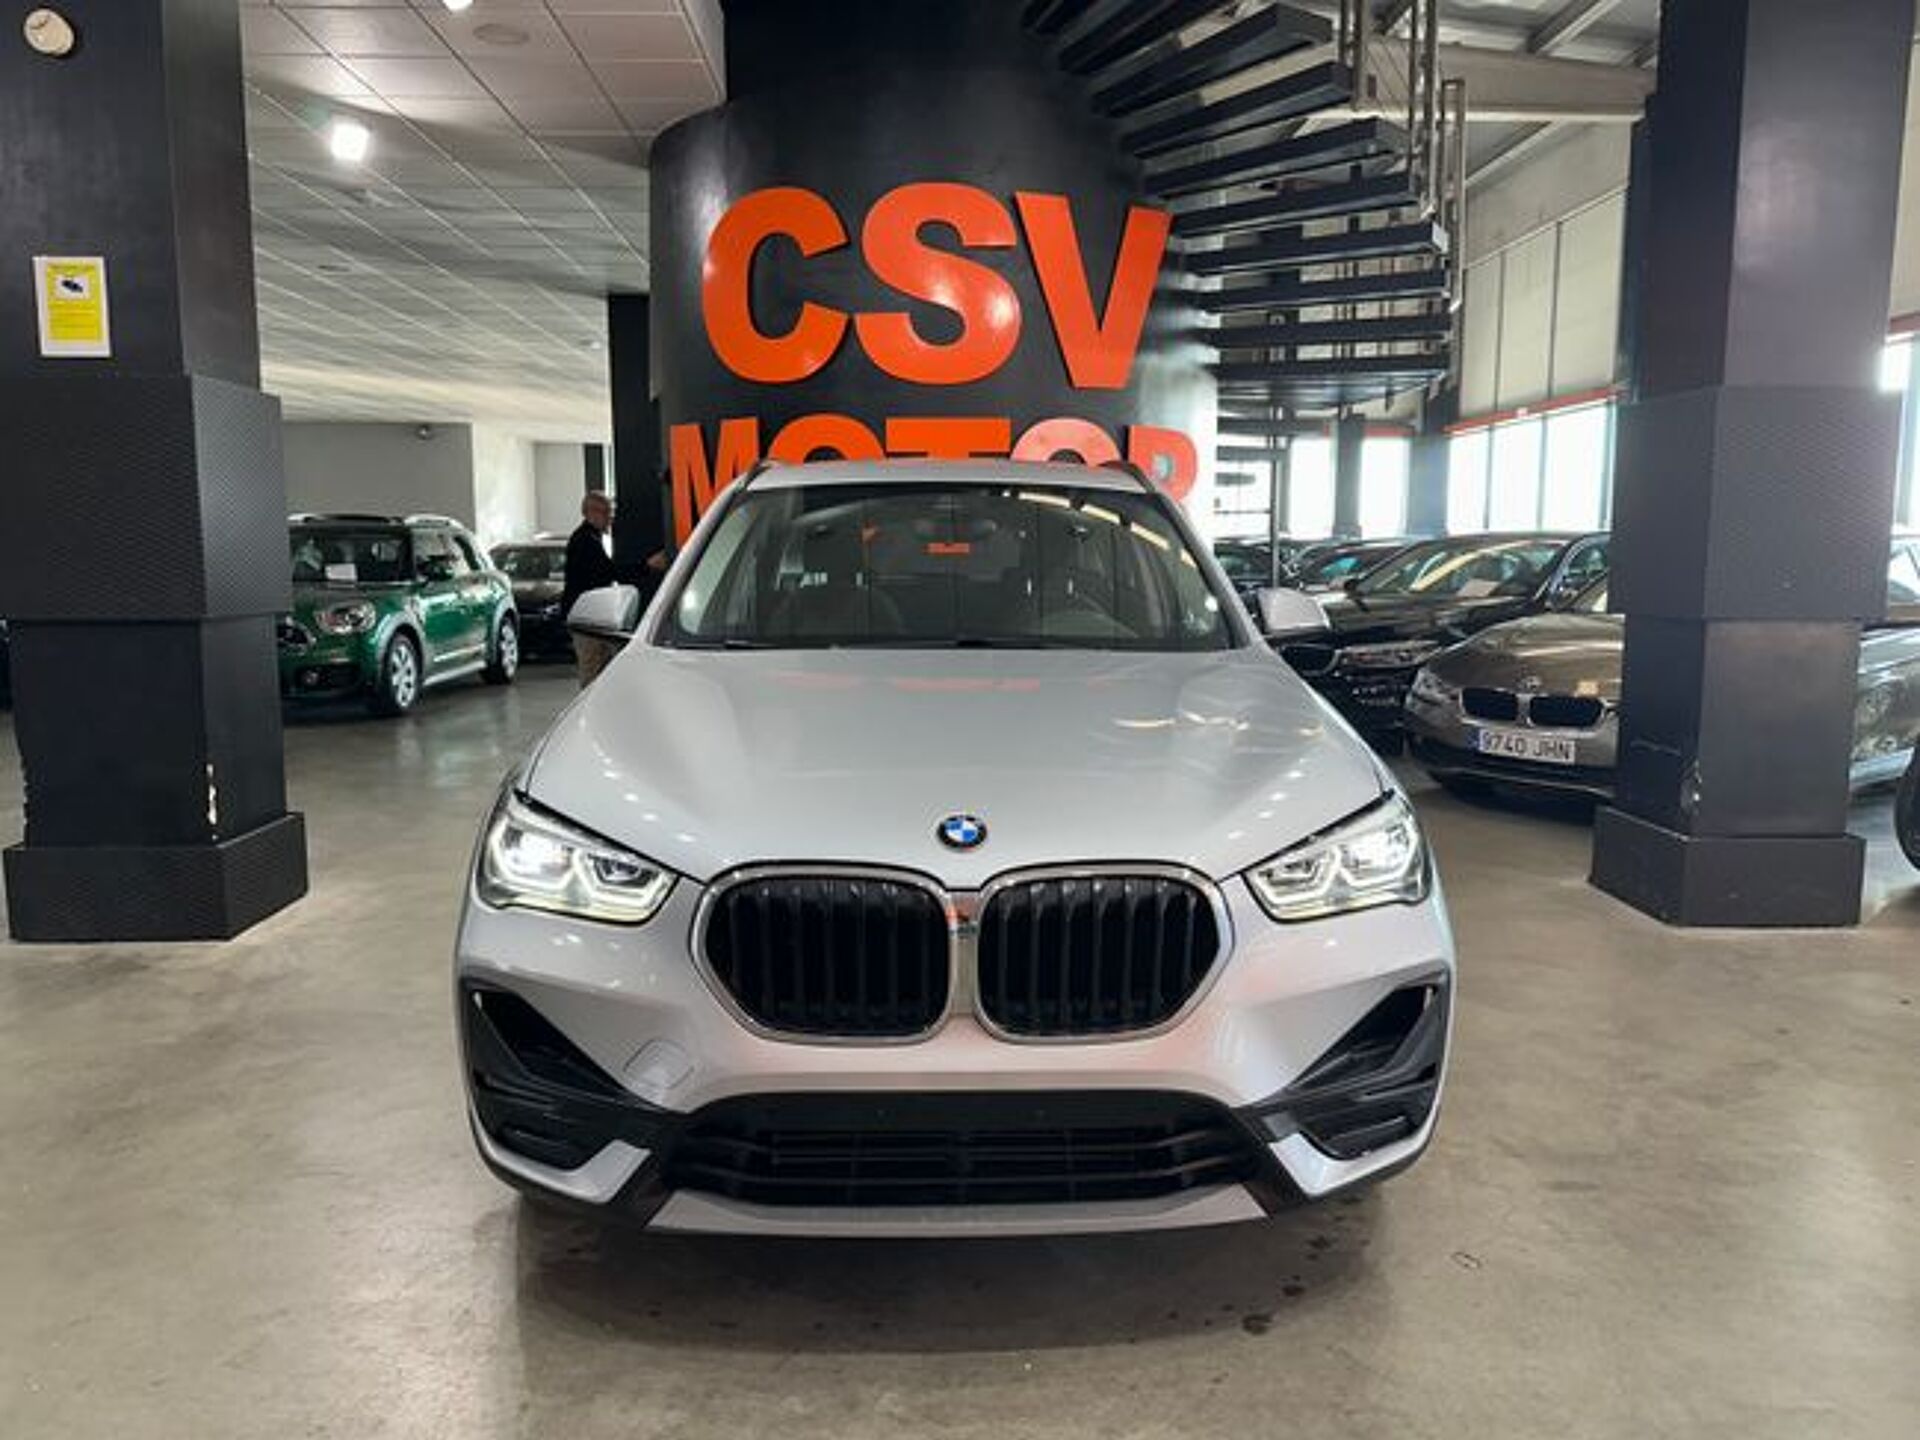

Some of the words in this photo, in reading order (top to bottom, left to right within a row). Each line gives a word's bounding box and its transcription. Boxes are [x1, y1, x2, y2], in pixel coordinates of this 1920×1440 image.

[703, 182, 1173, 388] CSV
[1483, 730, 1527, 754] 9740
[1532, 740, 1571, 761] JHN
